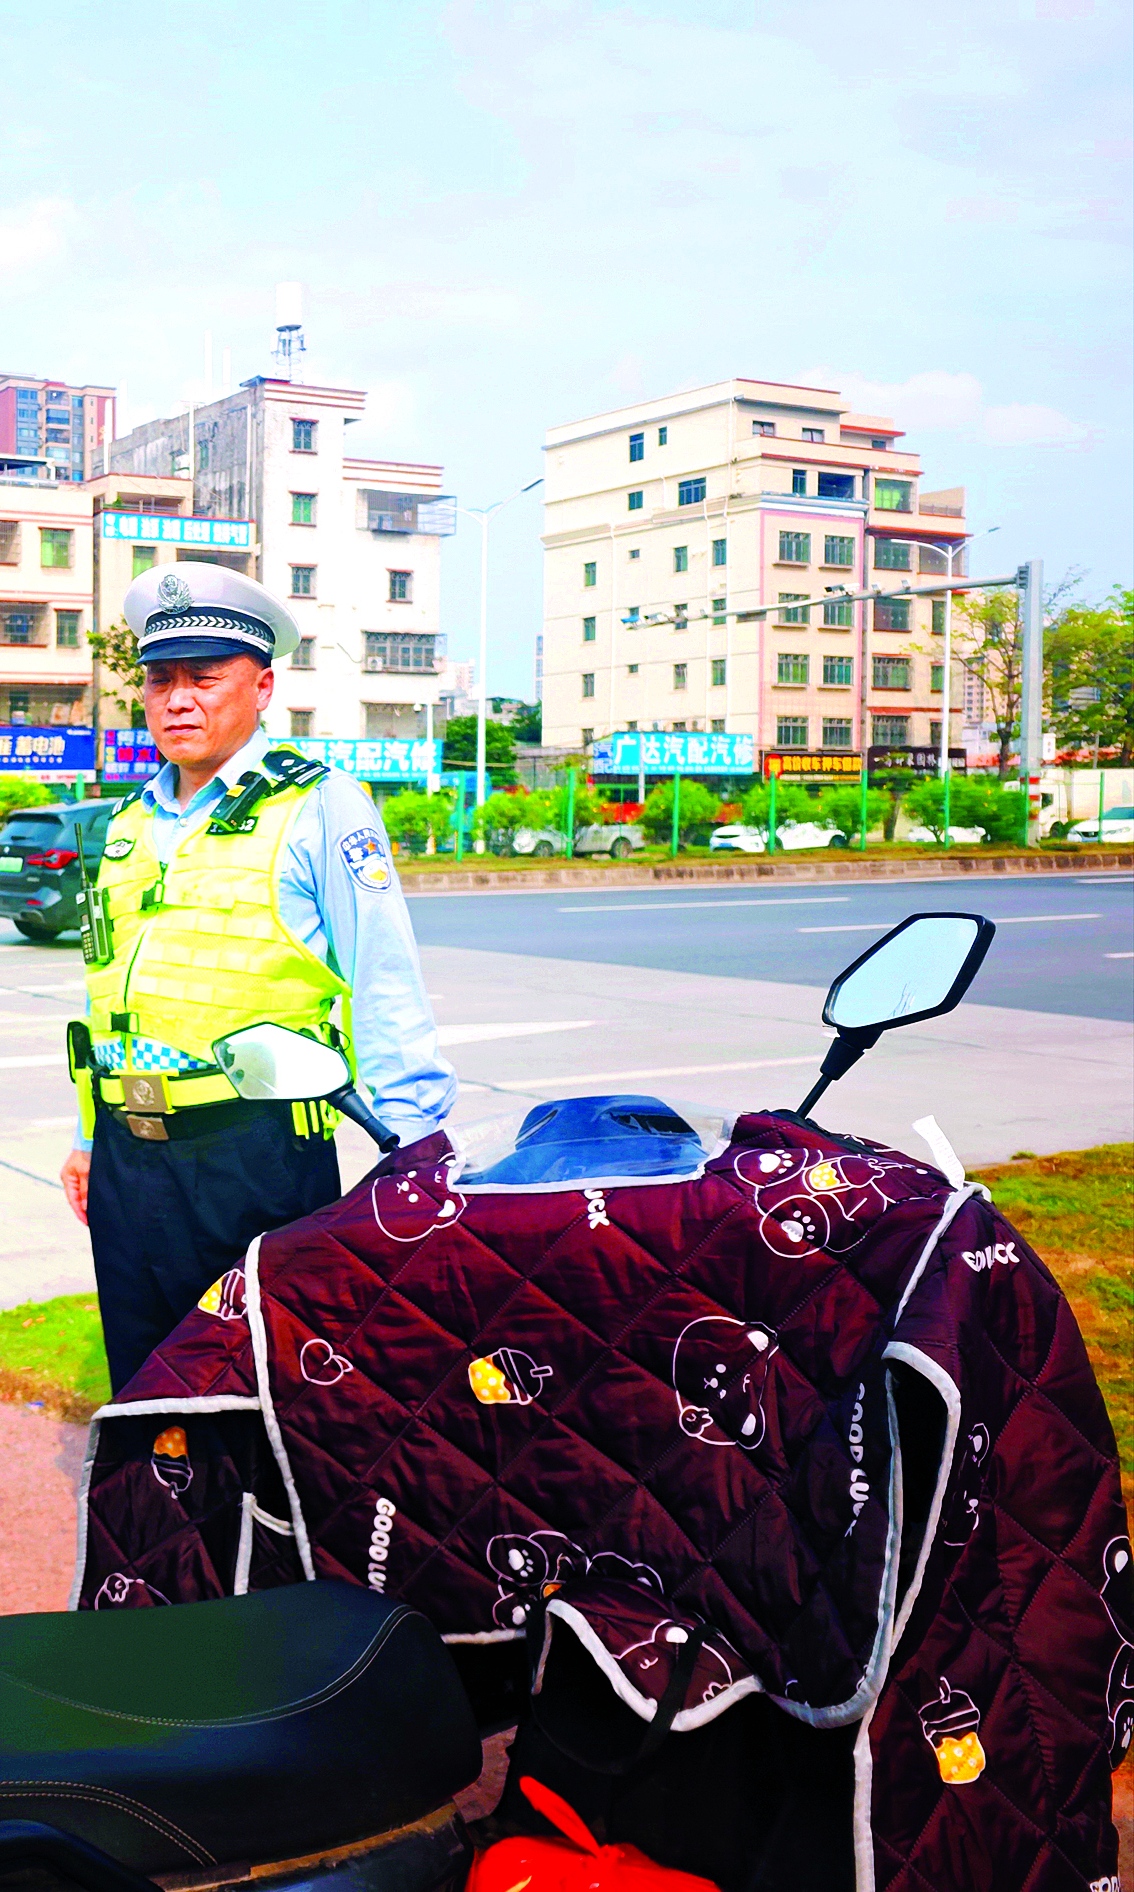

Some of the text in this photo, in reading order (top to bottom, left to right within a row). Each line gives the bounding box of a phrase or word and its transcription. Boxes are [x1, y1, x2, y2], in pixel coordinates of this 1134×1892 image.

[614, 735, 753, 765] 广达汽配汽修
[368, 1497, 396, 1562] GOOD
